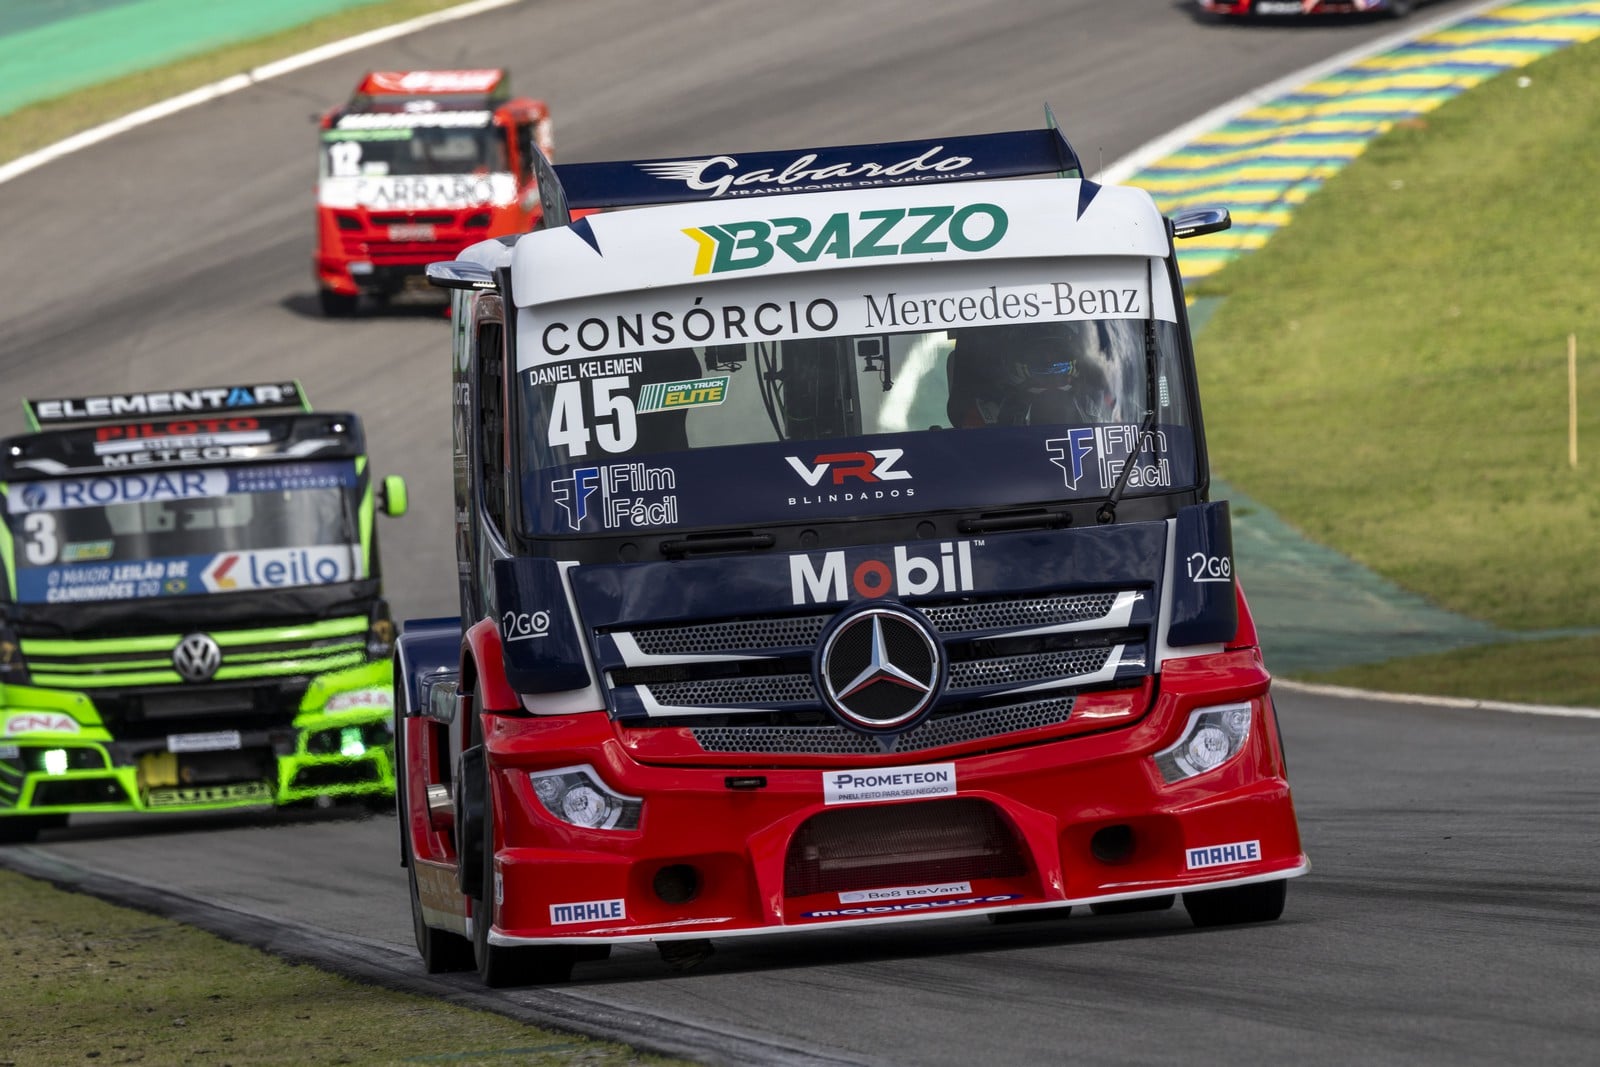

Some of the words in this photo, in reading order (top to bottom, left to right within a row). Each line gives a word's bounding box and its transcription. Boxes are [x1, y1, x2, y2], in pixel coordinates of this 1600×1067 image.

[684, 146, 973, 197] Gabardo
[357, 178, 494, 203] ARRARO
[729, 182, 853, 196] TRANSPORTE
[697, 203, 1009, 273] BRAZZO
[541, 297, 839, 356] CONSÓRCIO
[863, 282, 1141, 328] Mercedes-Benz
[529, 365, 577, 386] DANIEL
[579, 357, 643, 379] KELEMEN
[667, 383, 692, 393] COPA
[694, 379, 725, 390] TRUCK
[37, 386, 283, 418] ELEMENTAR
[664, 387, 724, 406] ELITE
[96, 417, 261, 442] PILOTO
[548, 376, 638, 457] 45
[1103, 425, 1168, 454] Film
[609, 463, 676, 493] Film
[784, 448, 913, 487] VRZ
[60, 471, 208, 505] RODAR
[788, 488, 915, 505] BLINDADOS
[611, 495, 679, 528] Fácil
[24, 512, 58, 565] 3
[112, 562, 165, 581] LEILÃO
[167, 560, 189, 577] DE
[250, 551, 339, 586] leilo
[789, 540, 974, 605] Mobil
[9, 716, 76, 732] CNA
[832, 771, 948, 789] PROMETEON
[860, 791, 880, 799] FEITO
[916, 786, 949, 795] NEGÓCIO
[1190, 842, 1257, 866] MAHLE
[906, 884, 967, 897] BeVant
[554, 901, 621, 922] MAHLE
